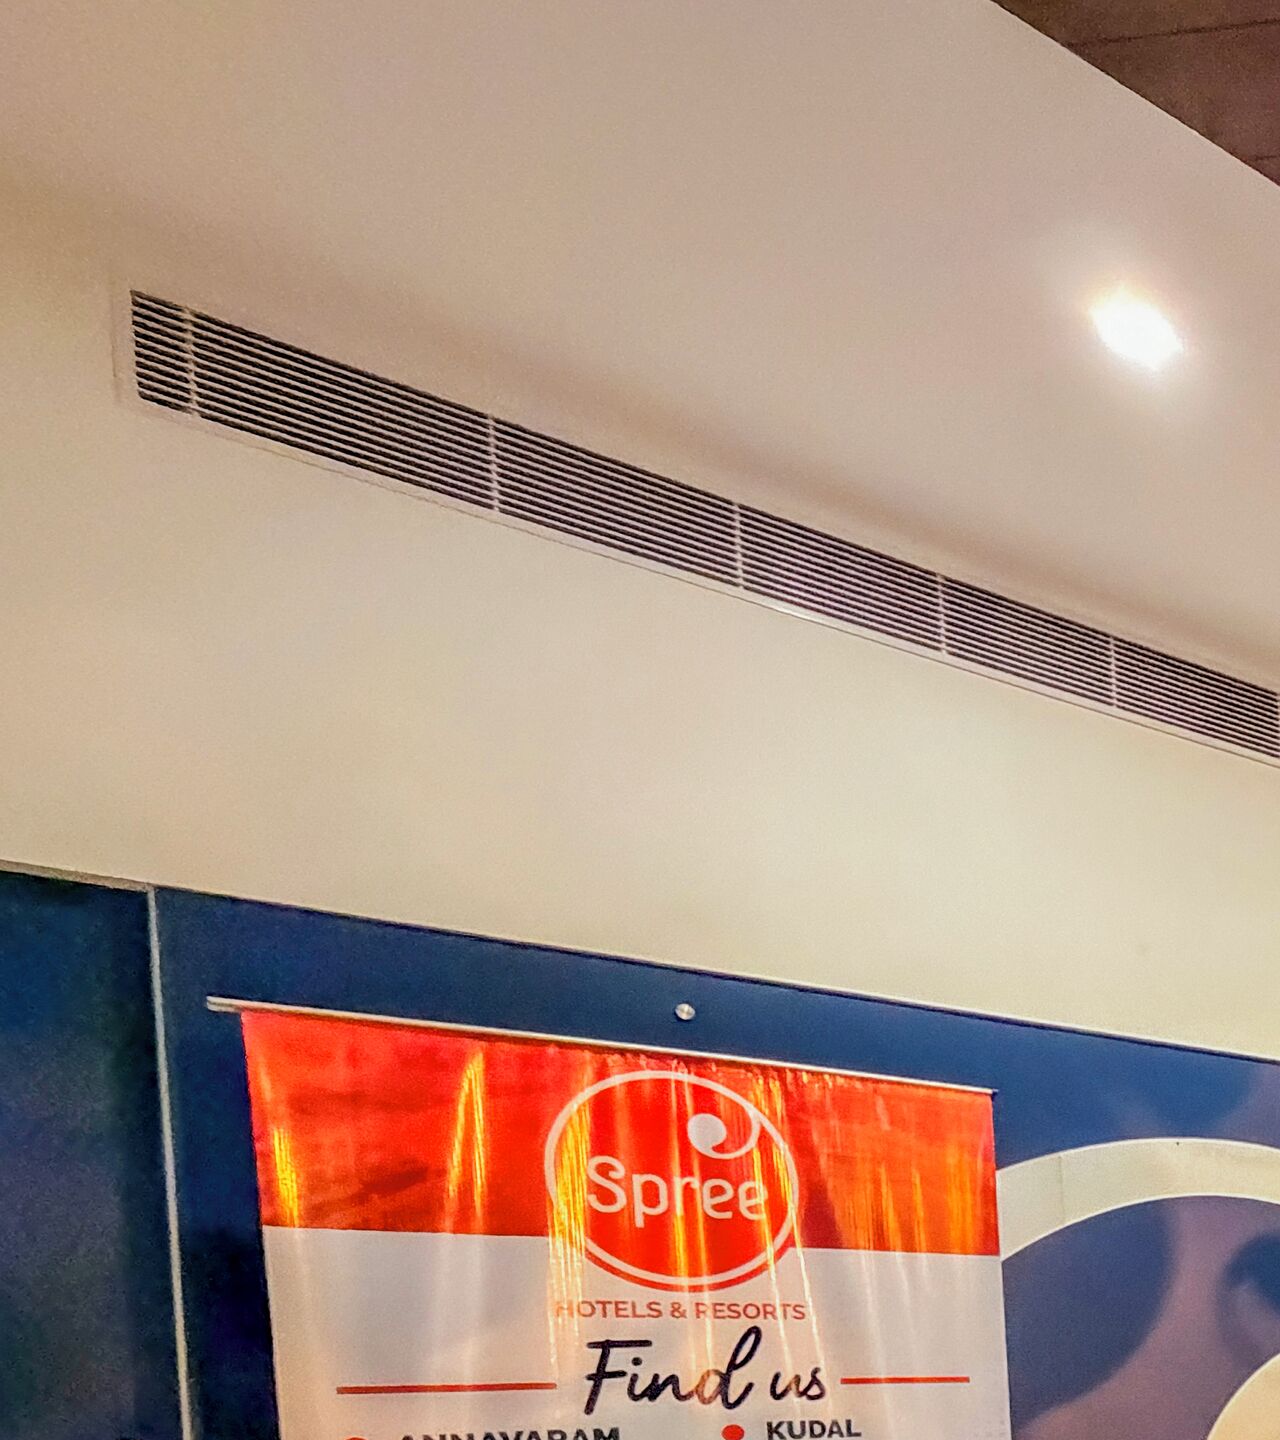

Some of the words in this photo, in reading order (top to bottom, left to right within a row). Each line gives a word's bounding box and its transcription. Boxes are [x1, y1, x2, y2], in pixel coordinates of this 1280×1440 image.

[586, 1154, 769, 1229] Spree
[556, 1299, 663, 1319] HOTELS
[669, 1301, 687, 1319] &
[695, 1301, 806, 1320] RESORTS
[584, 1325, 763, 1415] Find
[769, 1366, 826, 1401] us
[766, 1419, 862, 1440] KUDAL
